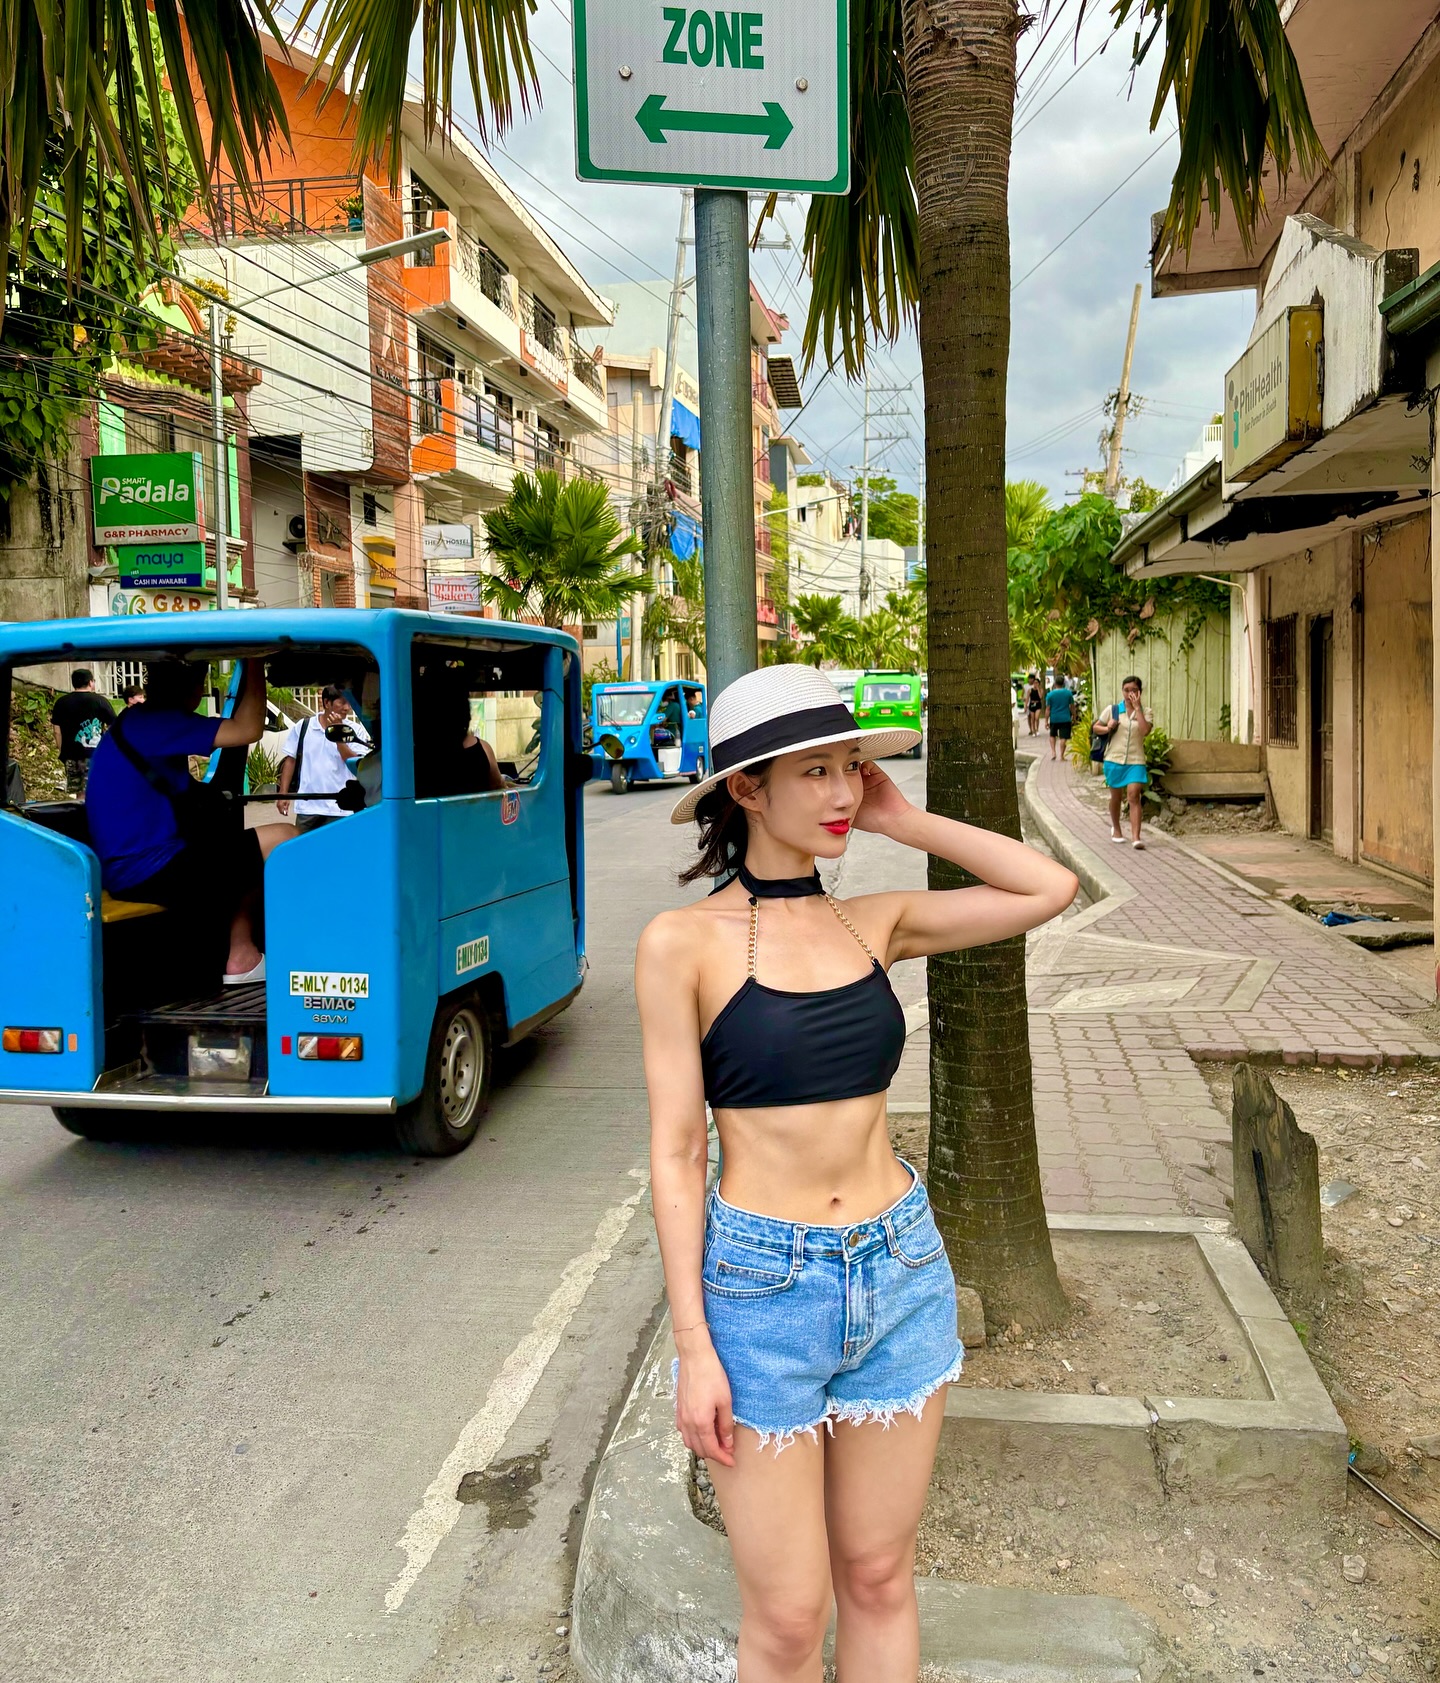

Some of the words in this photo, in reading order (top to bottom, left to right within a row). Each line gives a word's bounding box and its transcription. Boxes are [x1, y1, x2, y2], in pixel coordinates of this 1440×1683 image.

[662, 7, 764, 69] ZONE
[1239, 355, 1283, 419] PhilHealth
[122, 477, 146, 485] SMART
[100, 477, 189, 505] Padala
[104, 530, 125, 538] G&R
[128, 528, 189, 538] PHARMACY
[136, 552, 184, 568] maya
[158, 577, 188, 585] AVAILABLE
[303, 996, 356, 1011] BEMAC
